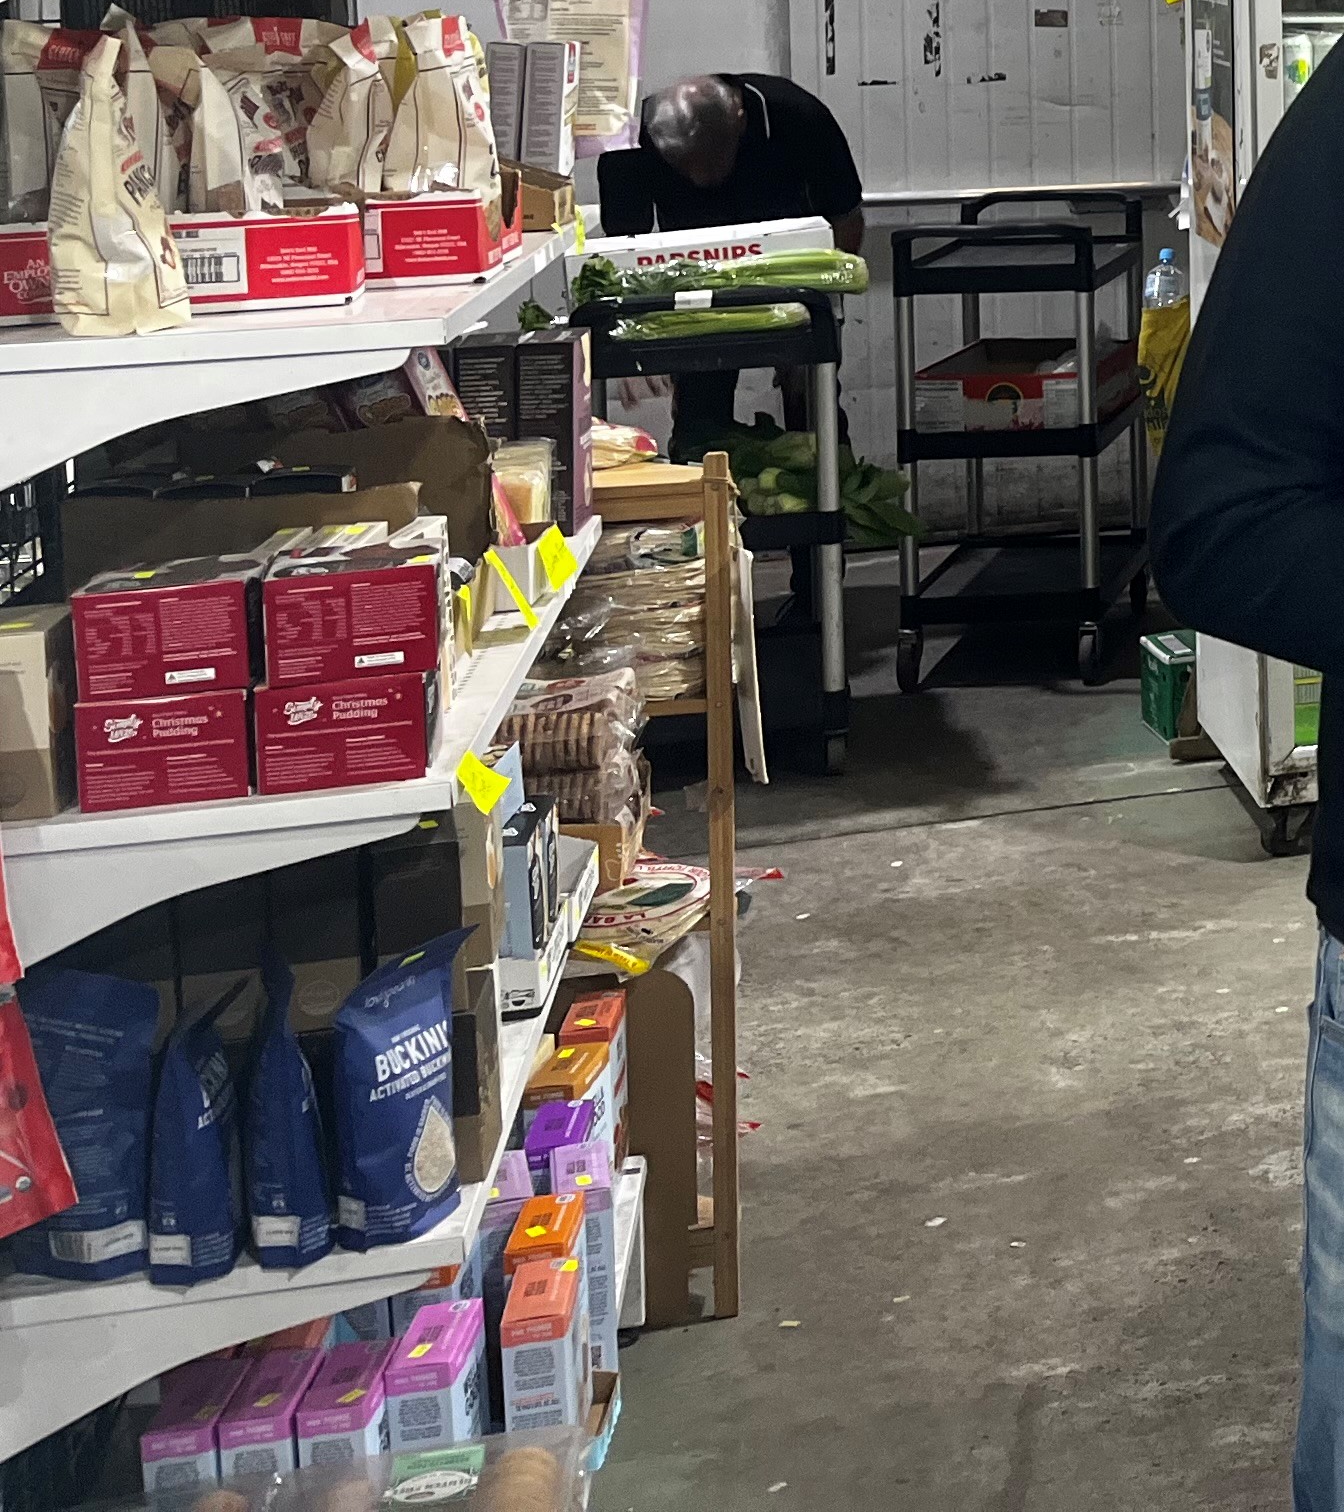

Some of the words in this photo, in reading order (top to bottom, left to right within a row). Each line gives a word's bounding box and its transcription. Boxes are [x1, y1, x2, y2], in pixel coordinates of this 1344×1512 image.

[332, 696, 389, 711] Christmas
[332, 706, 378, 721] Pudding
[151, 714, 209, 729] Christmas
[152, 724, 199, 738] Pudding
